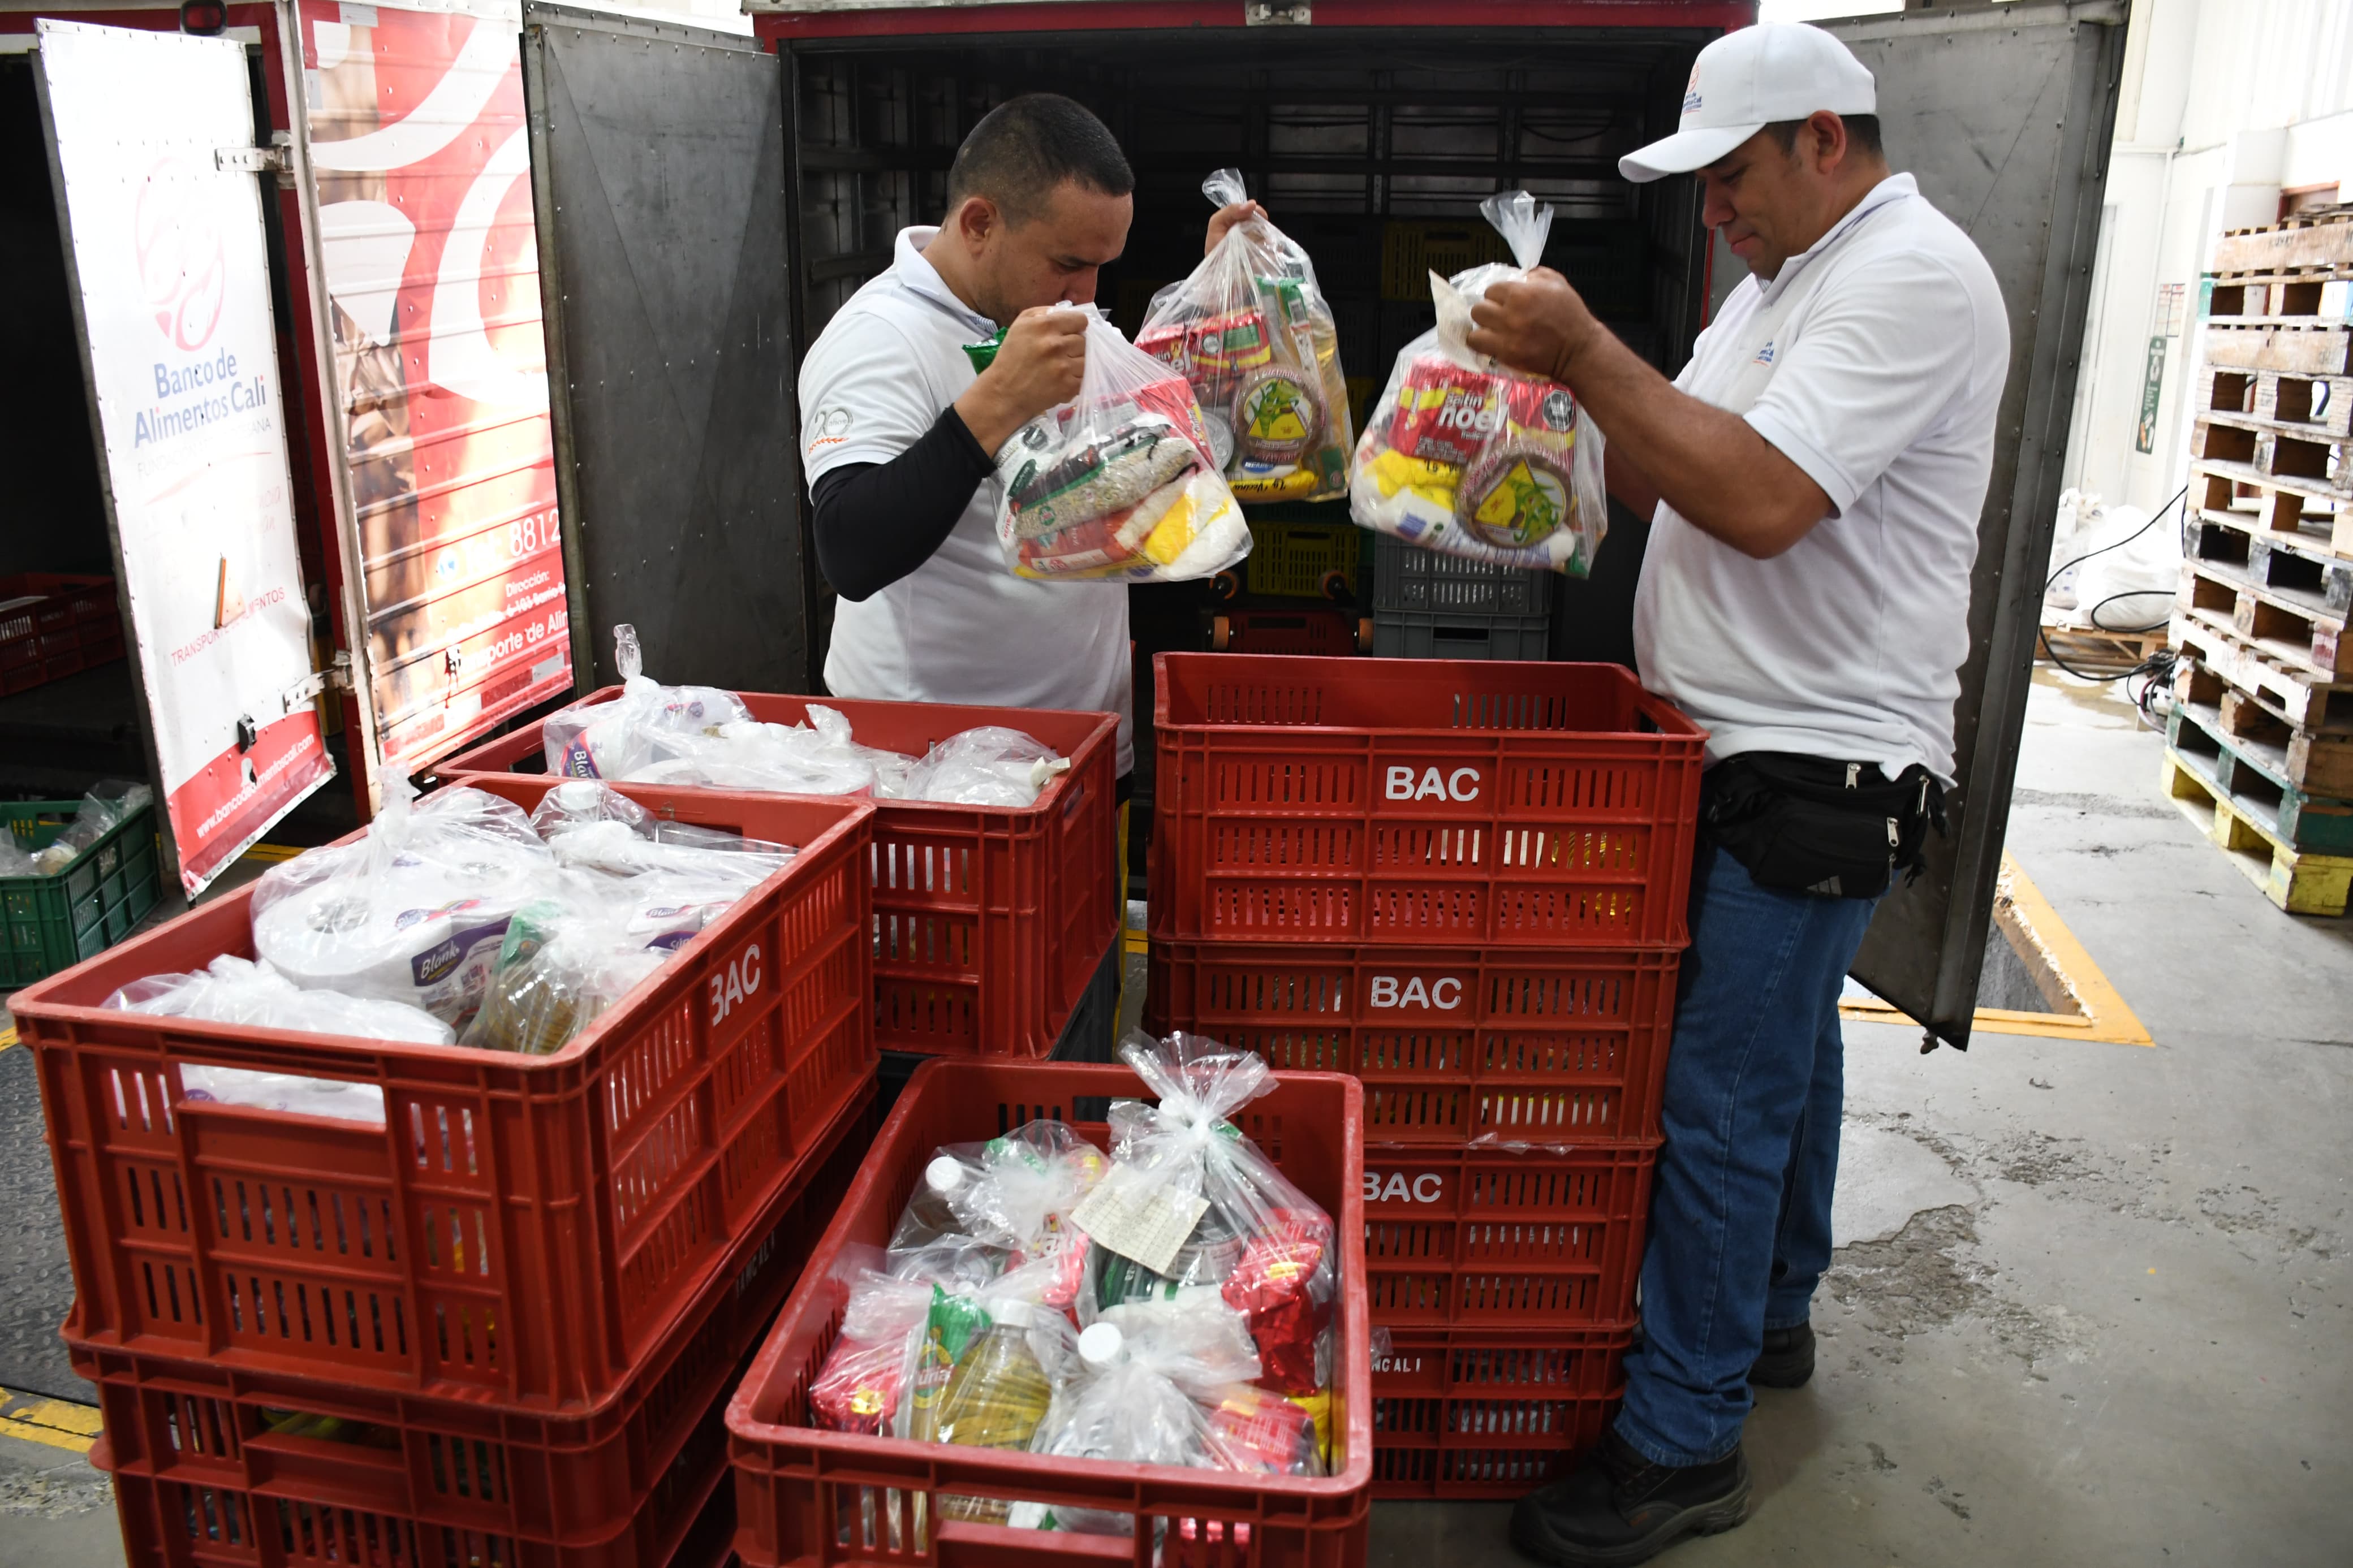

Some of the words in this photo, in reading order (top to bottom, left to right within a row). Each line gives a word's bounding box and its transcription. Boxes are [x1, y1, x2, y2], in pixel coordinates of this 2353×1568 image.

[153, 362, 213, 399] Banco
[216, 347, 238, 381] de
[135, 396, 229, 448] Alimentos
[231, 375, 266, 413] Cali
[815, 407, 853, 439] 20
[1437, 403, 1509, 434] noel
[524, 621, 545, 643] de
[1386, 766, 1480, 802] BAC
[1371, 976, 1462, 1010] BAC
[1363, 1171, 1442, 1203] BAC
